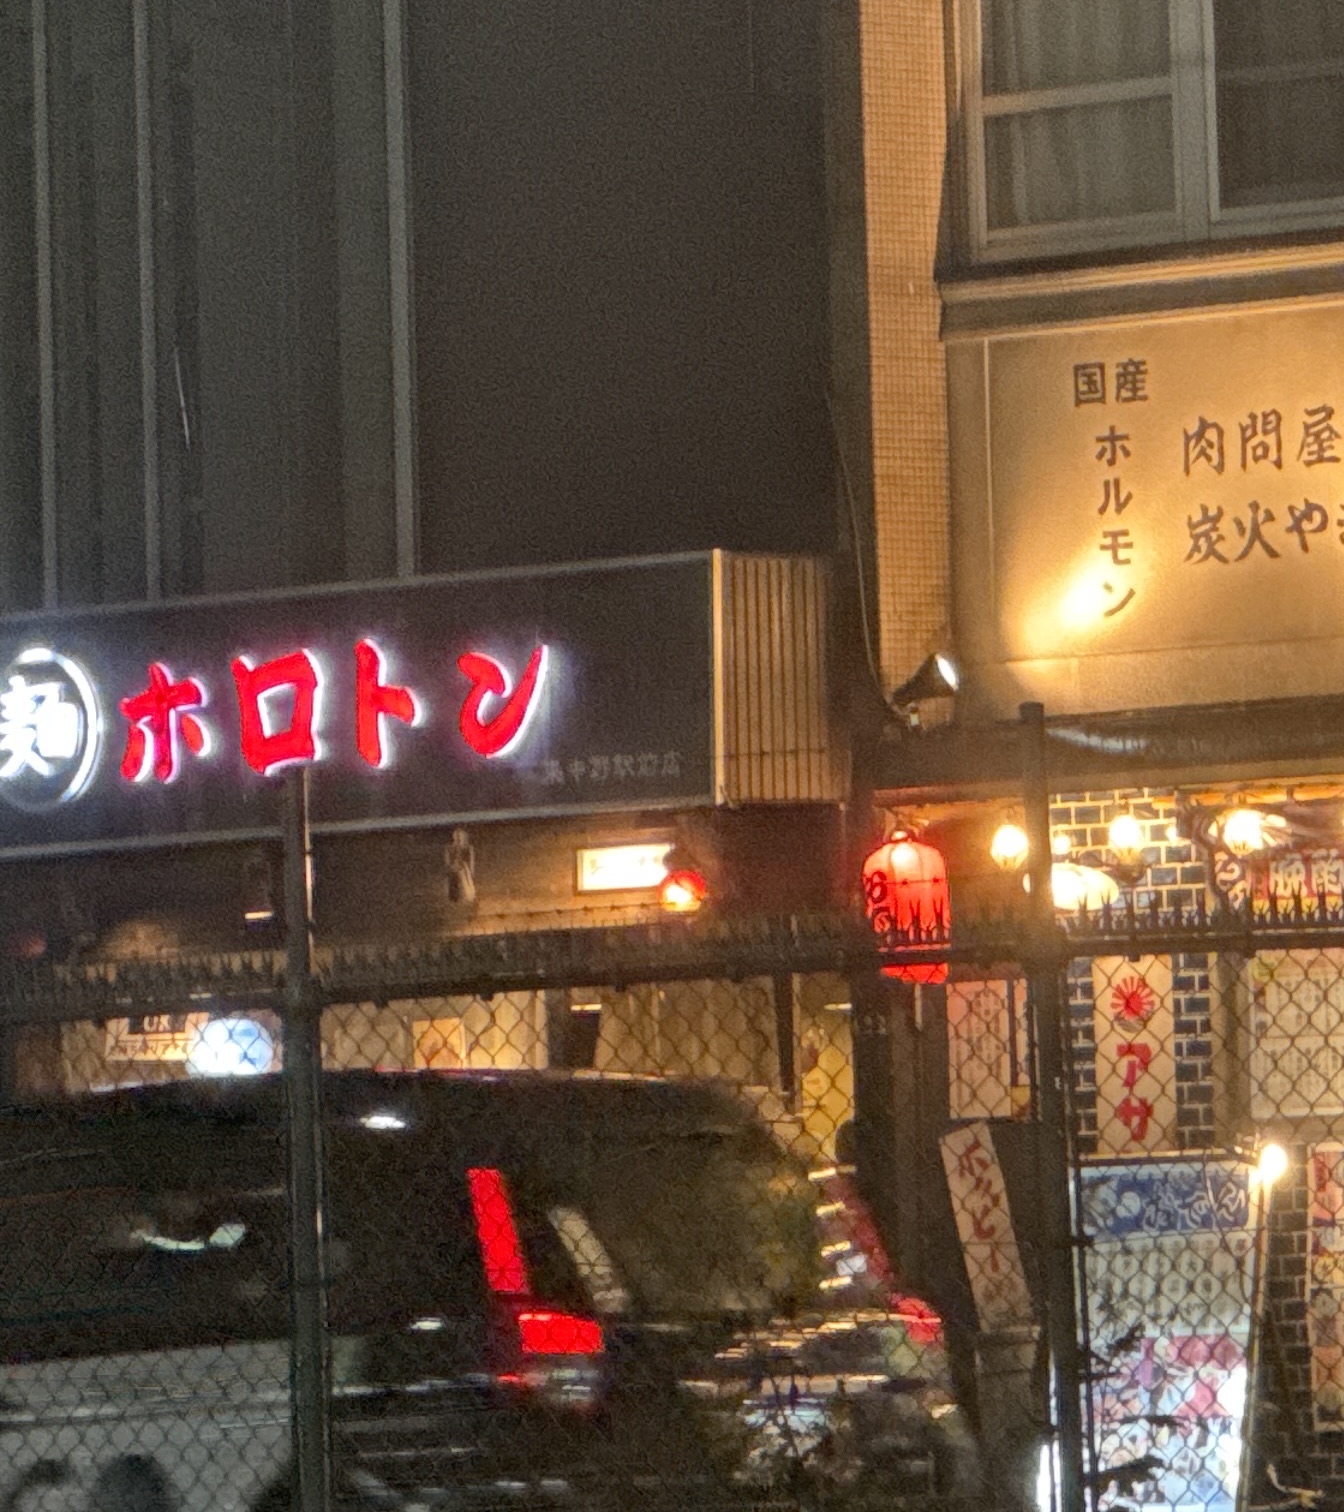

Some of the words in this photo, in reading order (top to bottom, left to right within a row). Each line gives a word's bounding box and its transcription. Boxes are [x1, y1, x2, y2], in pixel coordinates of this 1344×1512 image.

[1073, 358, 1149, 407] 国産
[1094, 425, 1136, 617] ホルモン
